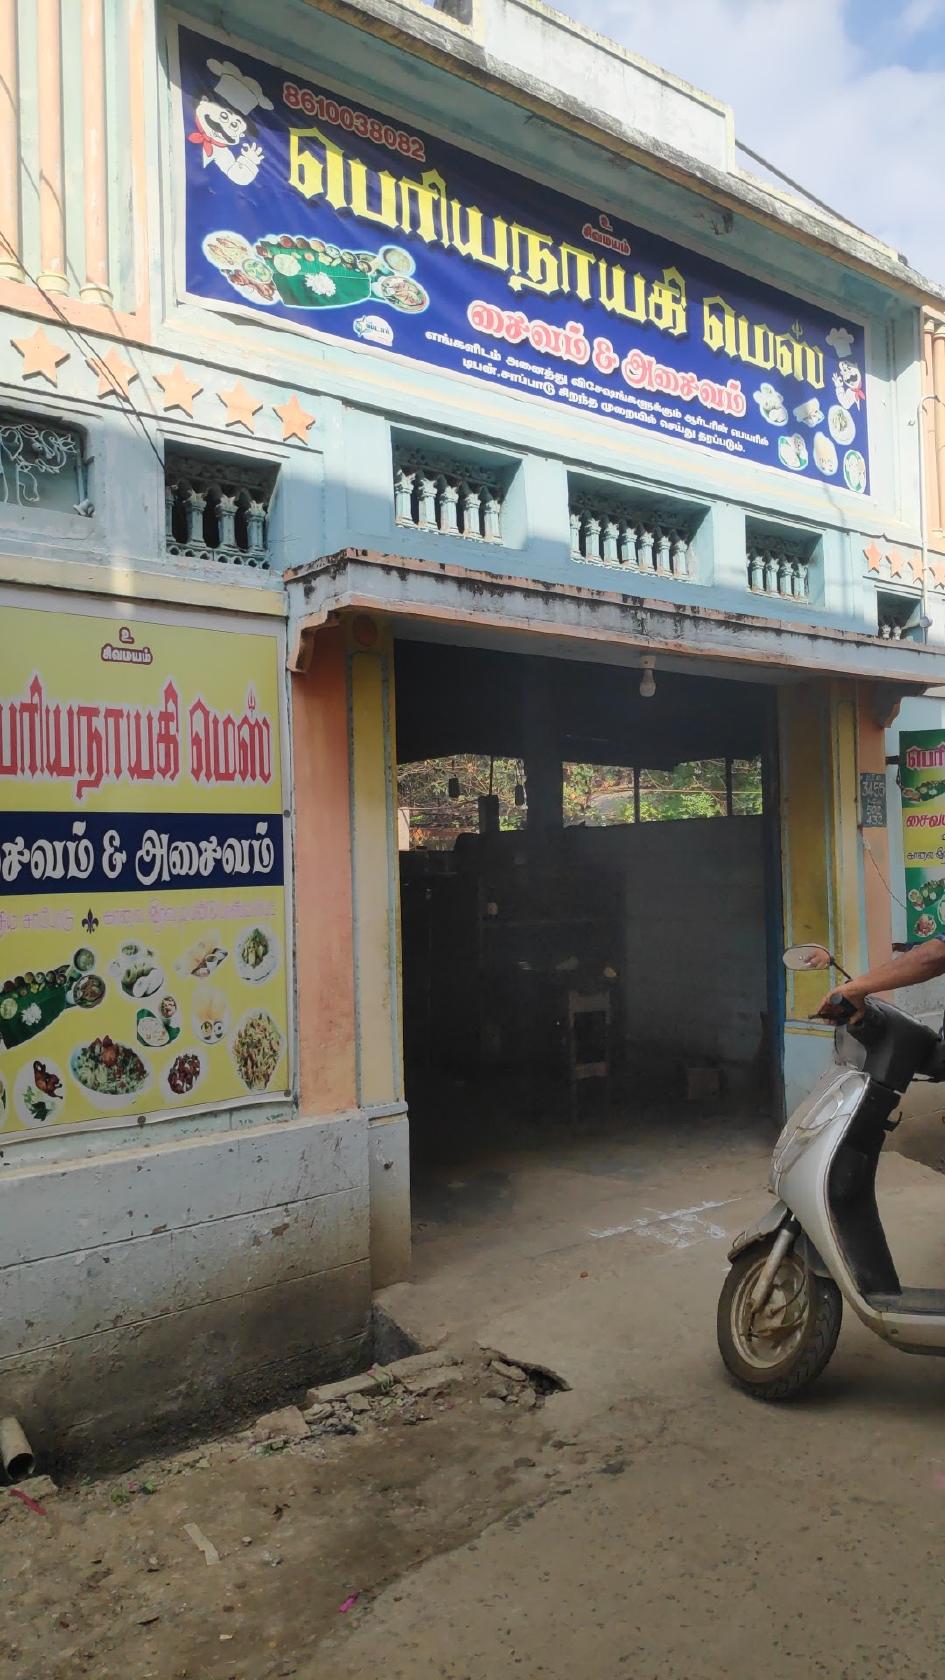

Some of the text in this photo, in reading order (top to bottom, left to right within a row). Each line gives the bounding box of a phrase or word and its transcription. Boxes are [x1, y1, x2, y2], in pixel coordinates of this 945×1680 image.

[283, 82, 427, 162] 8610038082
[288, 127, 825, 389] பெரியநாயகி மெஸ்
[582, 223, 631, 256] சிவமயம்
[425, 331, 502, 361] எங்களிடம்
[505, 356, 568, 386] அனைத்து
[467, 300, 747, 418] சைவம் & அசைவம்
[101, 644, 153, 665] சிவமயம்
[119, 627, 134, 644] உ
[189, 688, 272, 784] மெஸ்
[906, 815, 945, 828] சைவ
[0, 821, 274, 886] சவம் & அசைவம்
